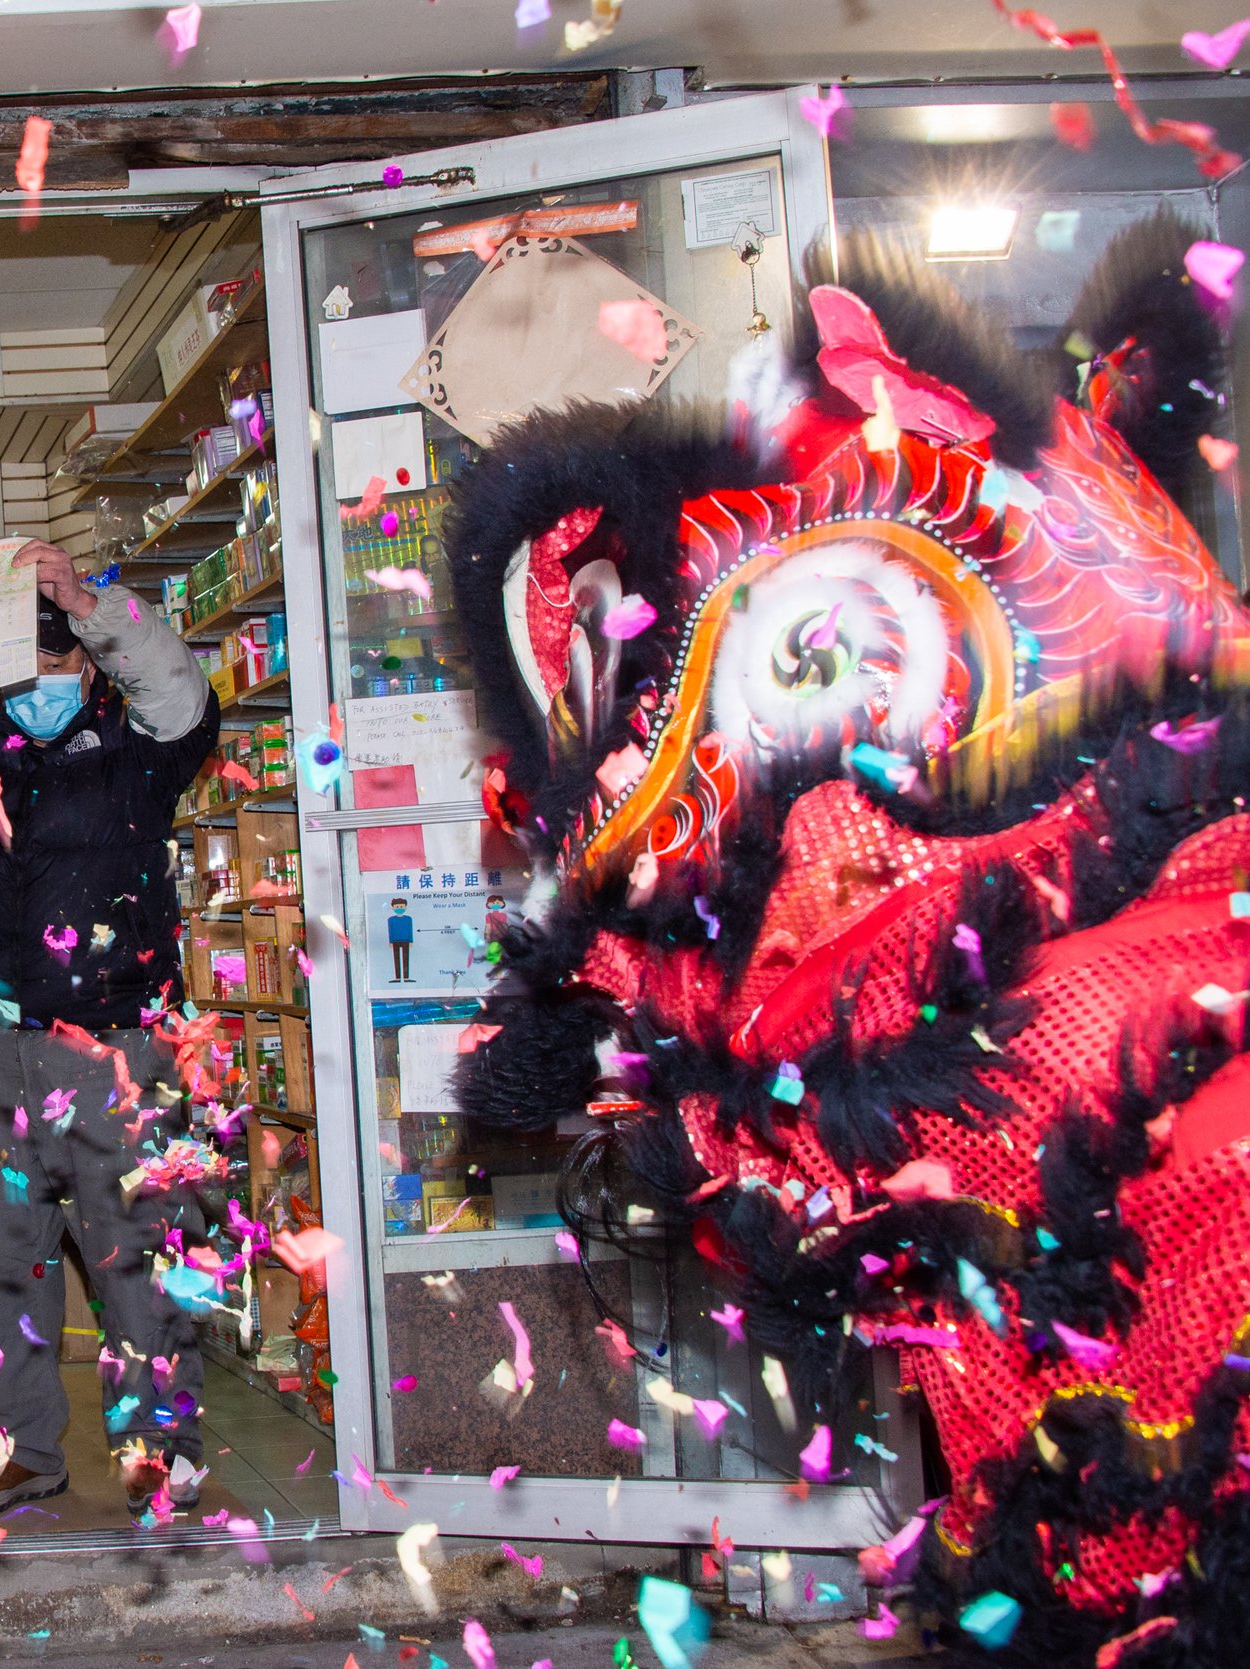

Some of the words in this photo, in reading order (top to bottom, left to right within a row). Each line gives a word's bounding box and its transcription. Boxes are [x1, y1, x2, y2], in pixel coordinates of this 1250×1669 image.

[351, 704, 365, 715] FOR
[370, 703, 410, 714] ASSISTED
[68, 744, 88, 755] FACE
[395, 871, 503, 890] 請保持距離
